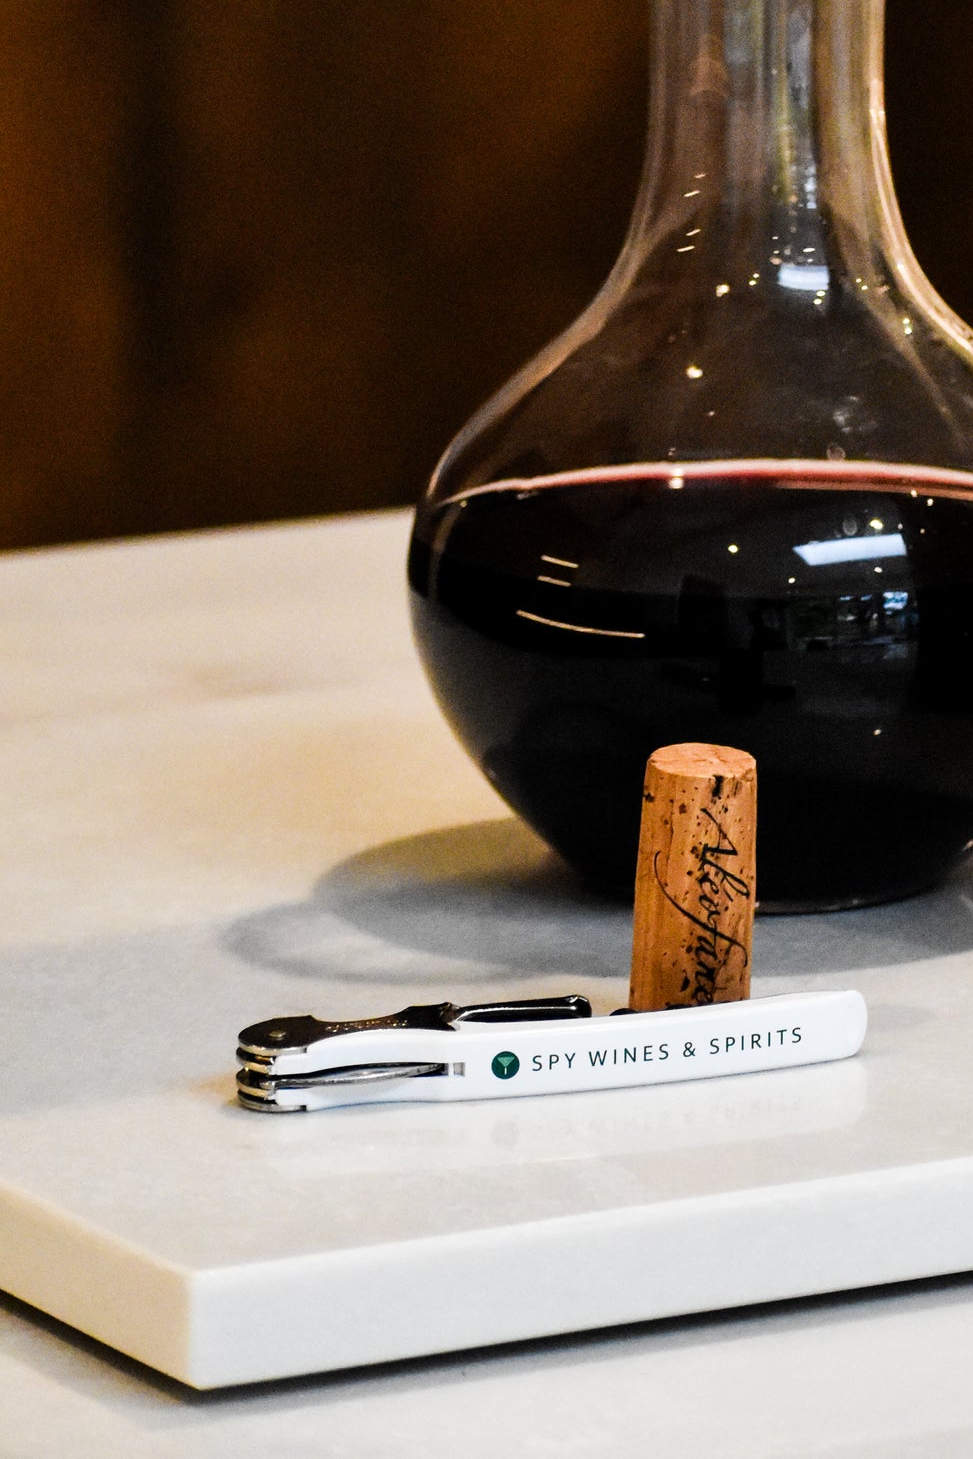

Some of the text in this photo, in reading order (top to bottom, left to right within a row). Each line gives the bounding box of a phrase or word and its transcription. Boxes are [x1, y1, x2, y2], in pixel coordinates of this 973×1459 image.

[532, 1027, 802, 1072] SPY WINES & SPIRITS
